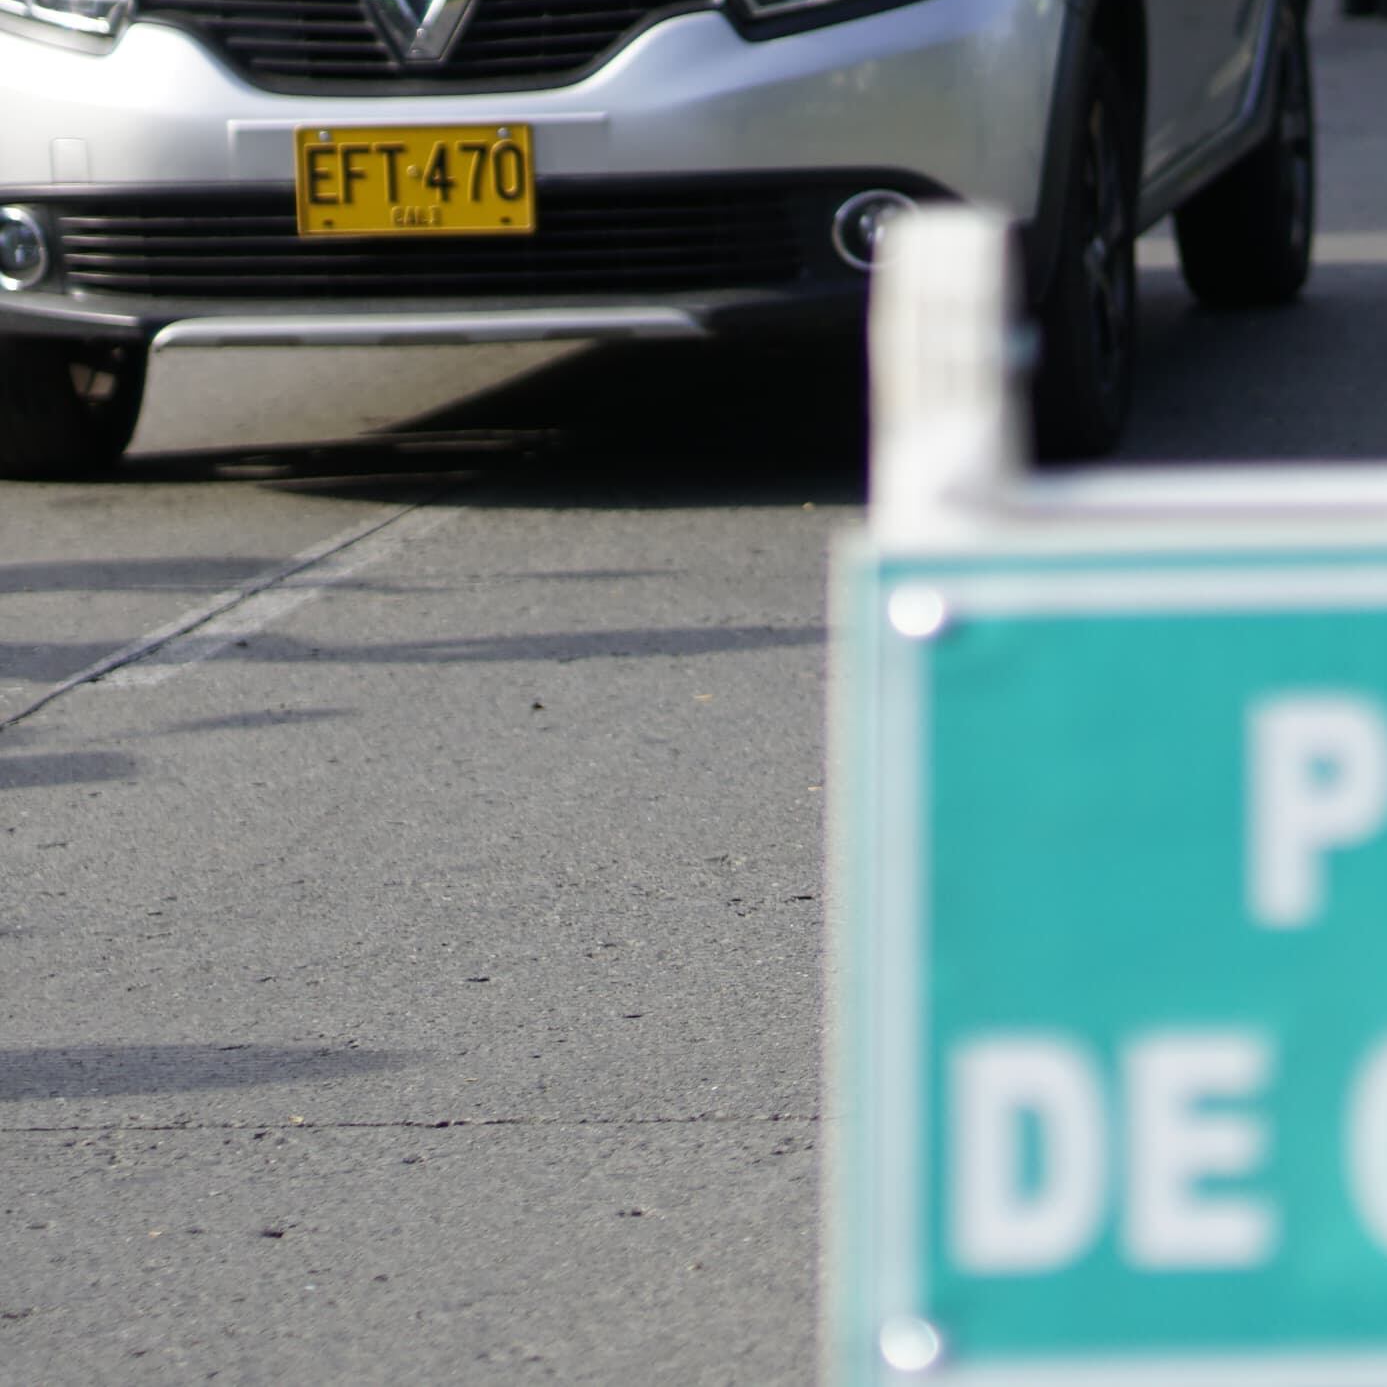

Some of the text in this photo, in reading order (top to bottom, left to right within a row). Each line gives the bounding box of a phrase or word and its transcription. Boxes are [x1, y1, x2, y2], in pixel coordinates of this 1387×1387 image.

[303, 140, 526, 205] EFT 470
[391, 205, 442, 226] CALI
[948, 1024, 1280, 1274] DE
